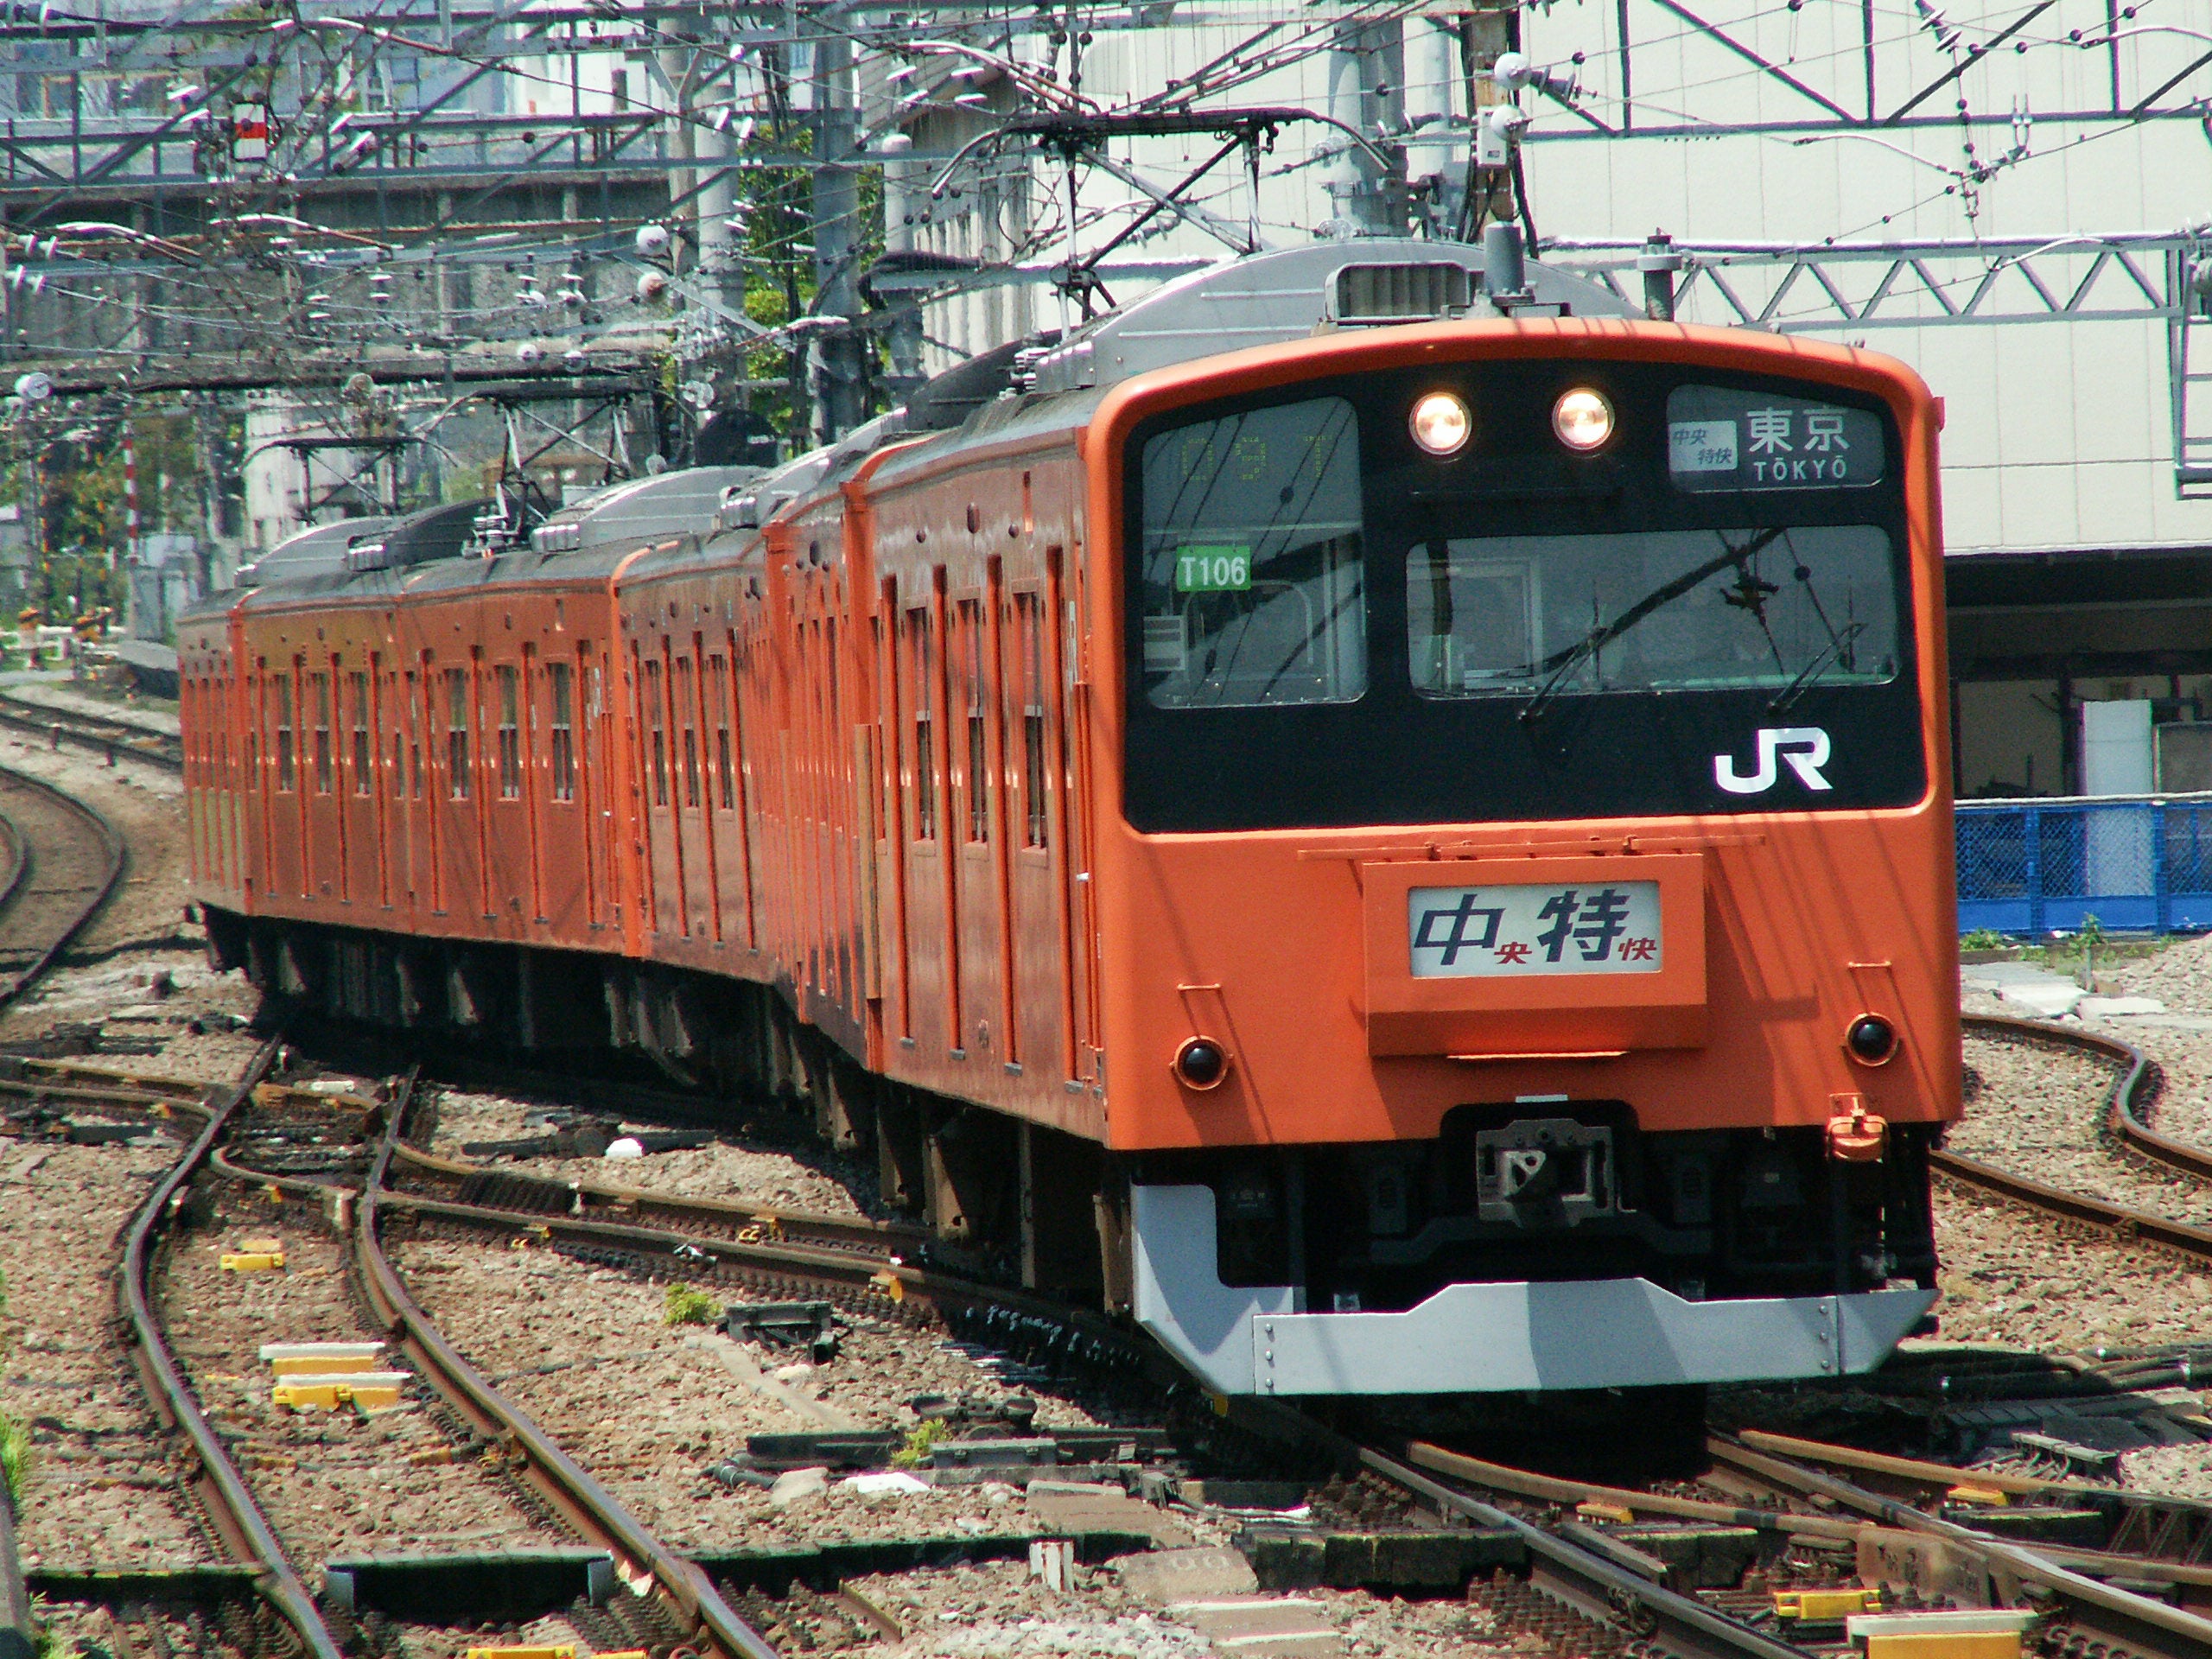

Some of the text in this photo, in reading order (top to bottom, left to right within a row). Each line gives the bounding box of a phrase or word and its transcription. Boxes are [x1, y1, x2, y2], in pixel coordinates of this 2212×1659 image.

[1672, 429, 1707, 444] 中央
[1747, 406, 1850, 453] 東京
[1695, 448, 1732, 464] 特快
[1180, 557, 1246, 586] T106
[1714, 727, 1834, 793] JR
